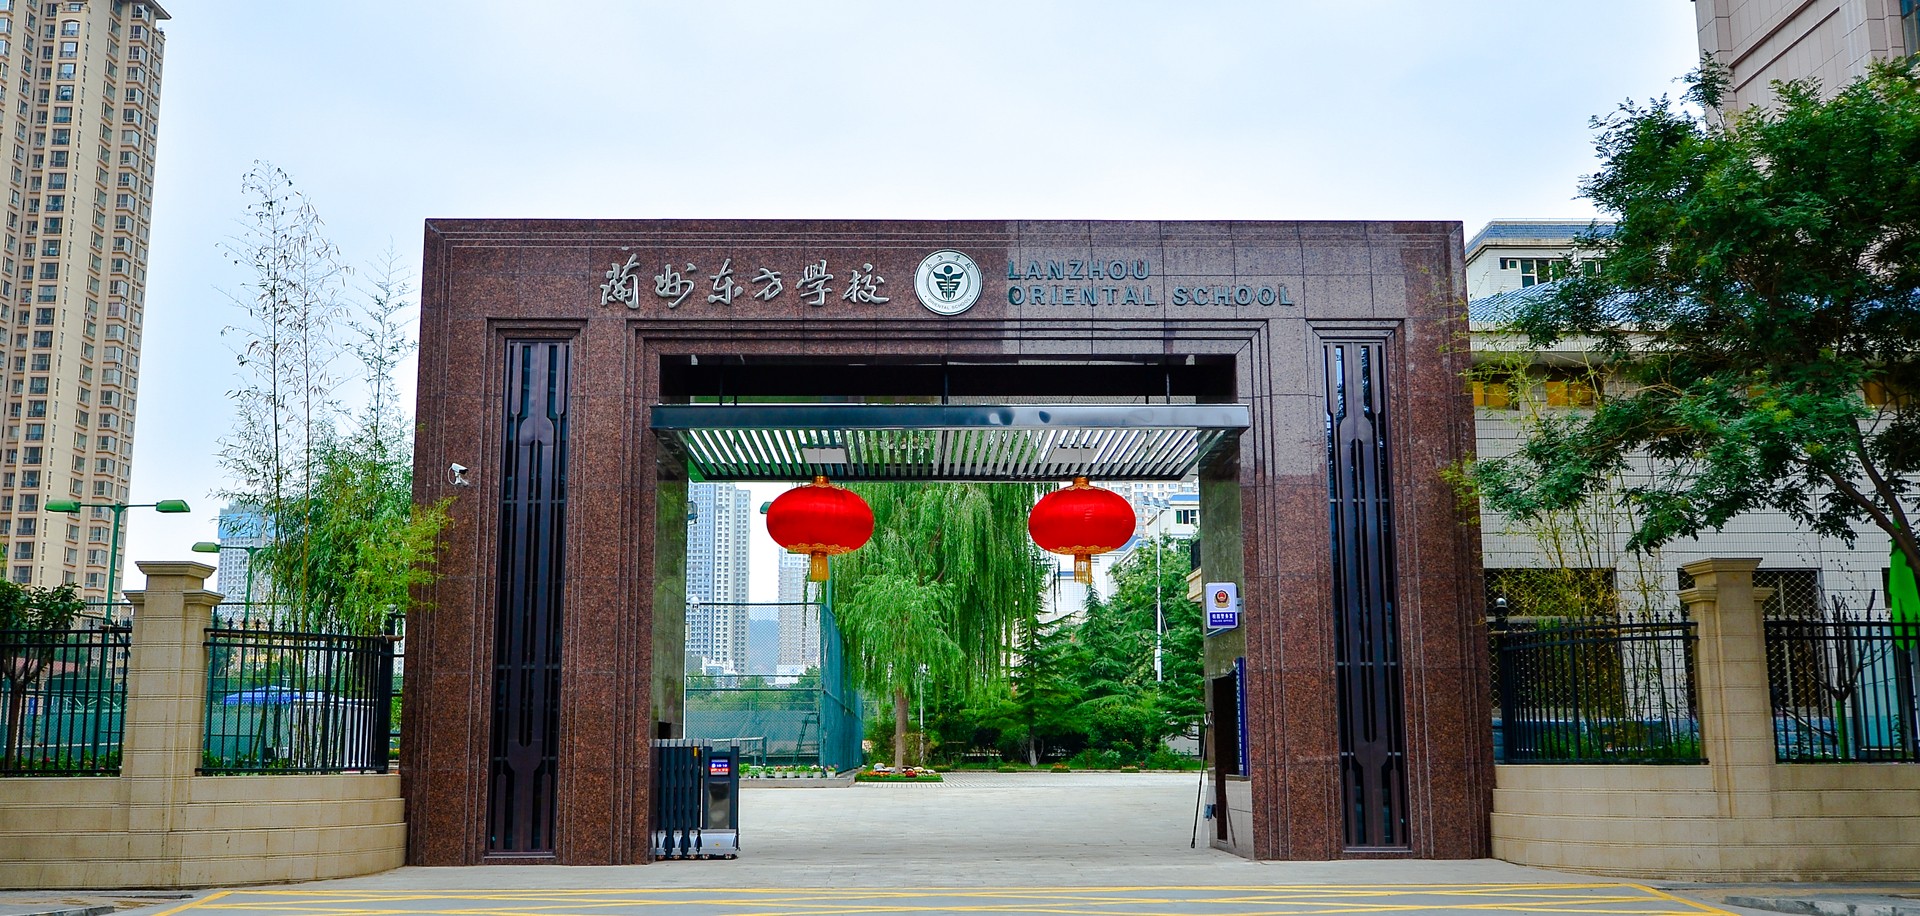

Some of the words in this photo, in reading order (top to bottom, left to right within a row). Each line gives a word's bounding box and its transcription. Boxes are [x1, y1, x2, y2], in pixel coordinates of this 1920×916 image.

[1008, 260, 1150, 280] LANZHOU
[1008, 286, 1157, 306] ORIENTAL
[1173, 286, 1293, 306] SCHOOL
